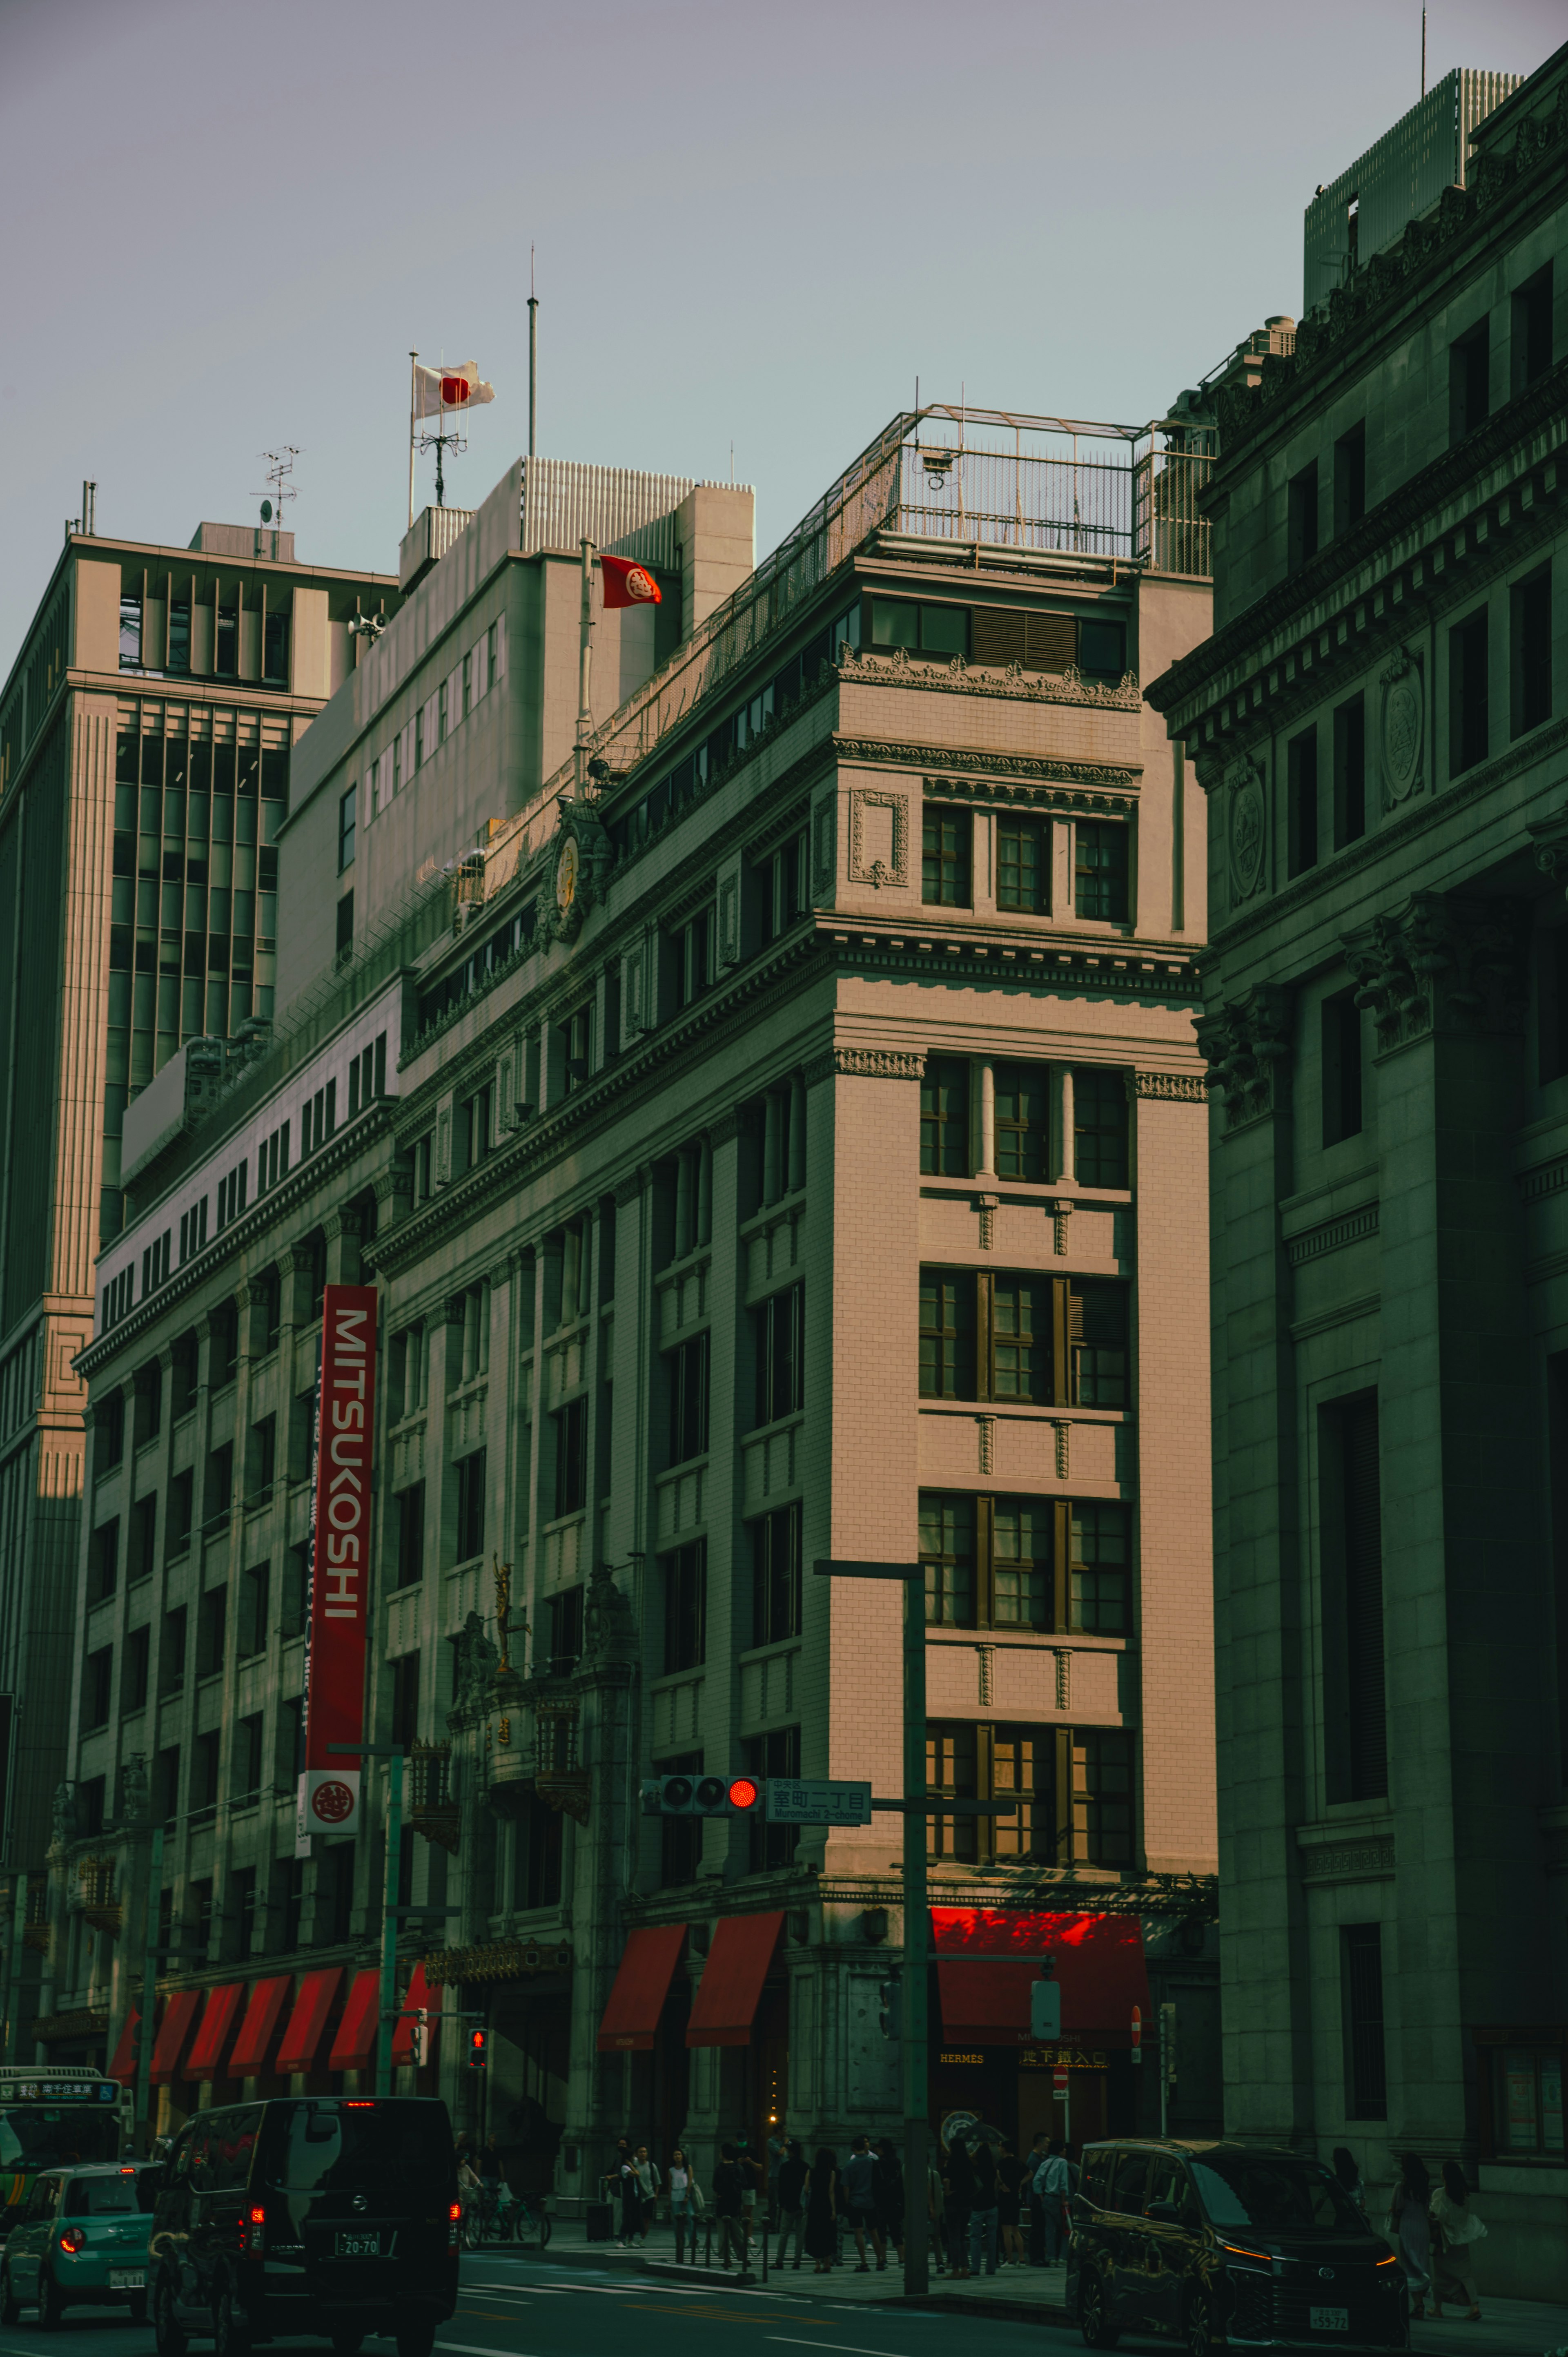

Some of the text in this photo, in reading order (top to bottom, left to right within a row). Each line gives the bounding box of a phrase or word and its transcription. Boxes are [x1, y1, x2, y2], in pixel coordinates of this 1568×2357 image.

[324, 1309, 368, 1619] MITSUKOSHI
[773, 1779, 801, 1789] 中央区
[773, 1790, 864, 1809] 室町二丁目
[775, 1808, 863, 1820] Muromachi 2-chome
[345, 2241, 377, 2253] 20-70
[1318, 2316, 1346, 2329] 59-72
